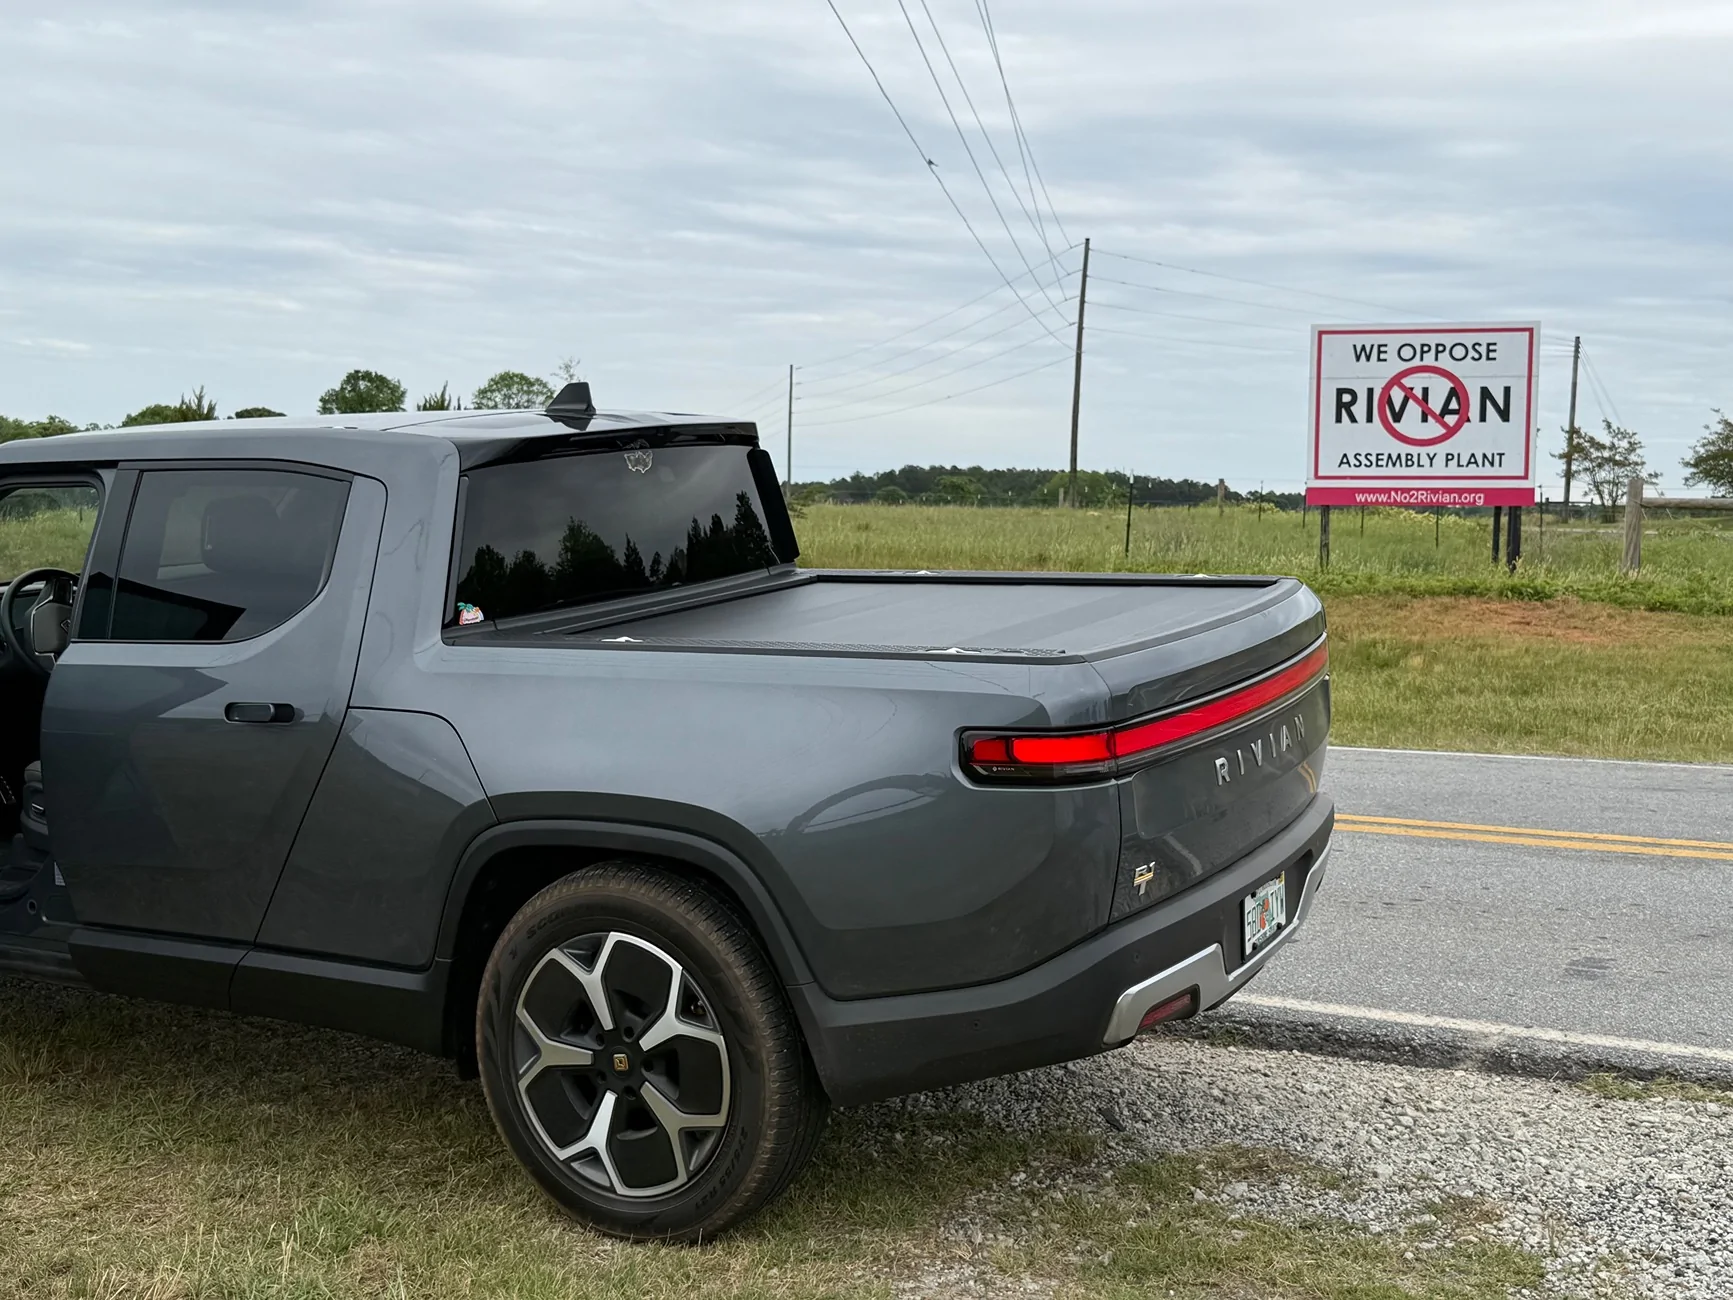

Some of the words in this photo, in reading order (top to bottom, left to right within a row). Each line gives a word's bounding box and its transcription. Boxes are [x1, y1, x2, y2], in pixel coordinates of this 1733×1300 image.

[1353, 343, 1388, 362] WE
[1397, 342, 1497, 362] OPPOSE
[1334, 386, 1511, 424] RIVIAN
[1338, 452, 1437, 468] ASSEMBLY
[1445, 452, 1505, 468] PLANT
[1355, 490, 1484, 505] www.No2Rivian.org
[1215, 714, 1305, 785] RIVIAN
